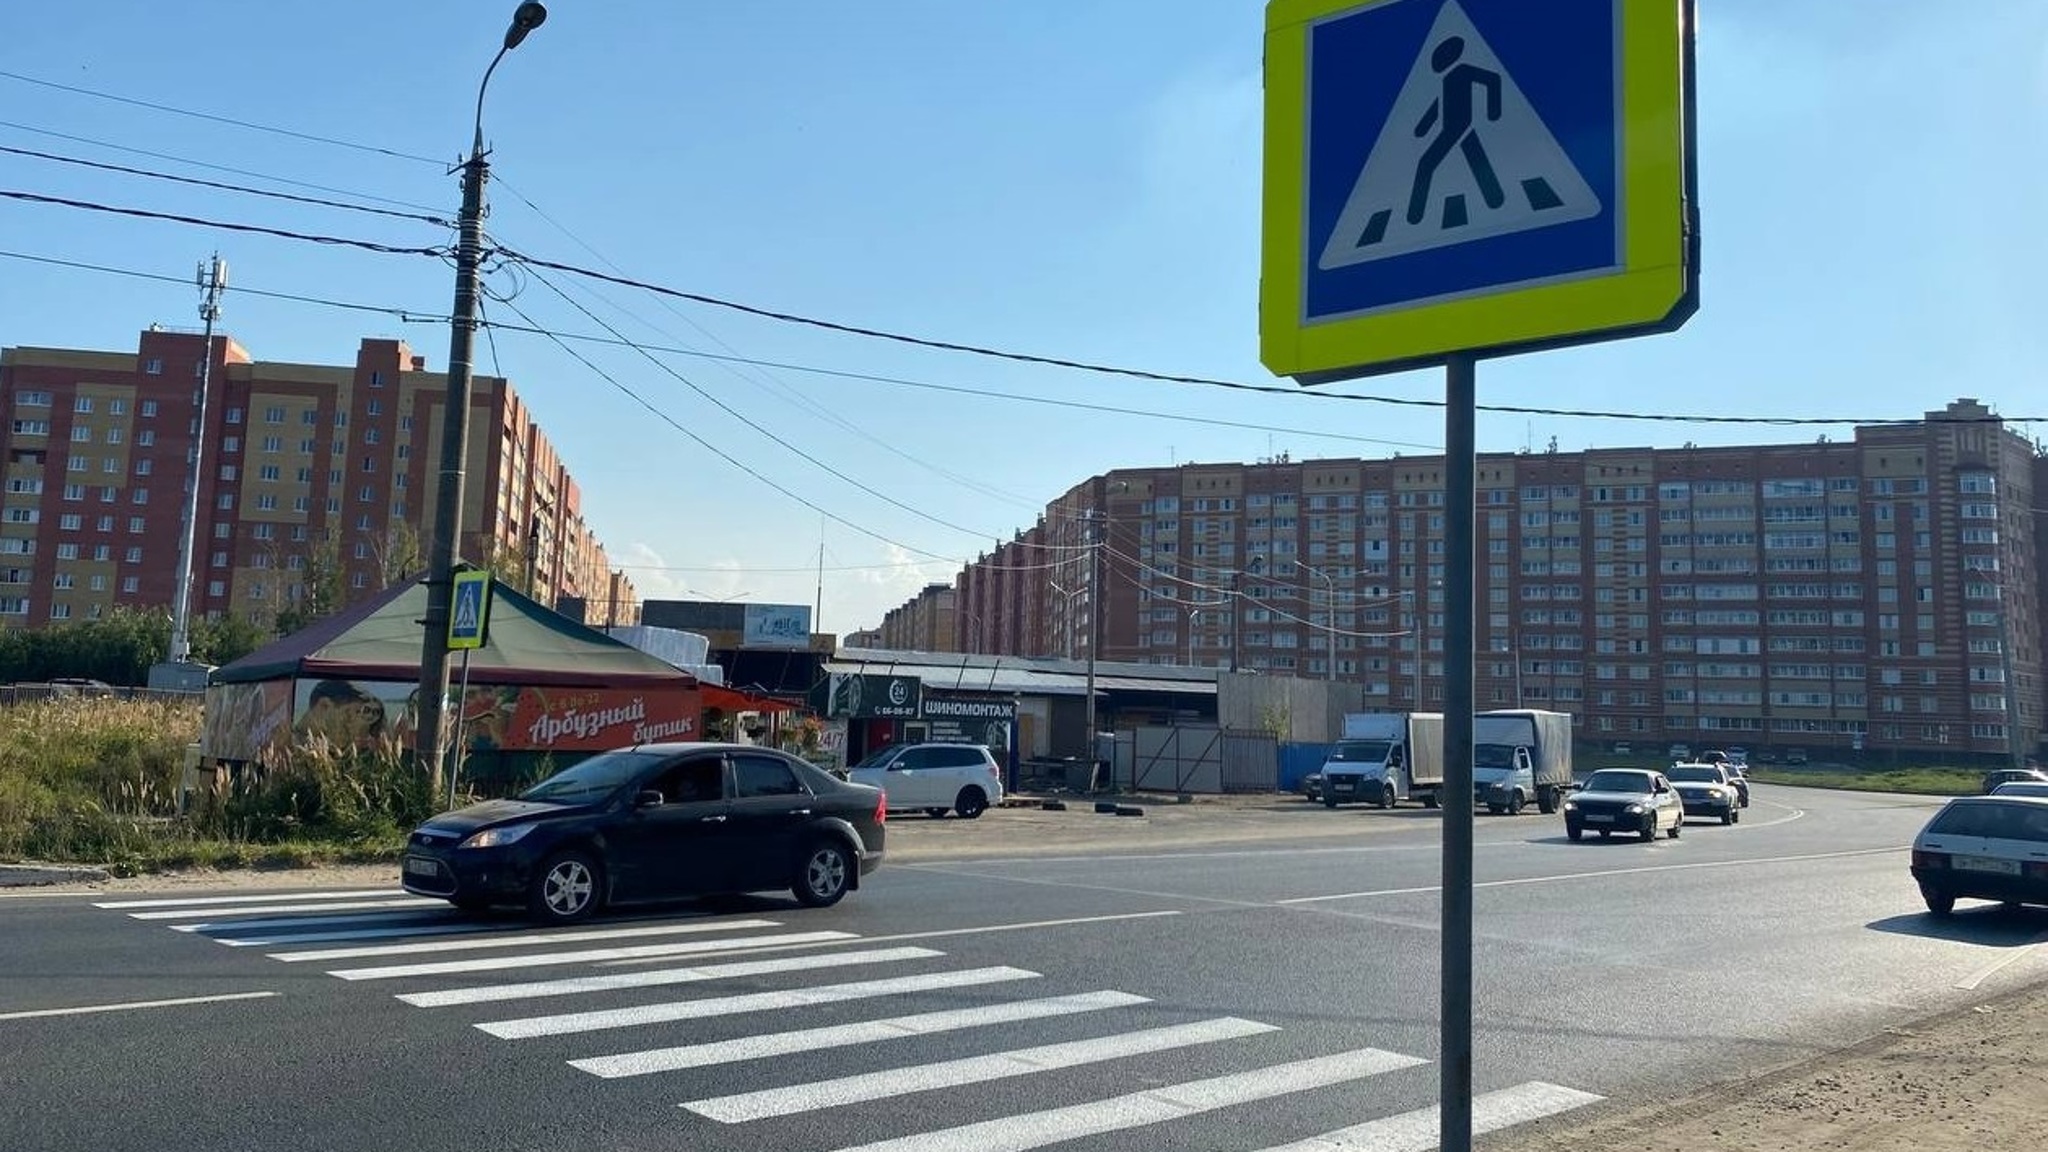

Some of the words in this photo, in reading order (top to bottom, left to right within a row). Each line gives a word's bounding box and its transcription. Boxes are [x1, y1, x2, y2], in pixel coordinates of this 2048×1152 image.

[530, 697, 645, 743] Арбузный
[925, 701, 1013, 717] ШИНОМОНТАЖ
[632, 718, 692, 745] бутик
